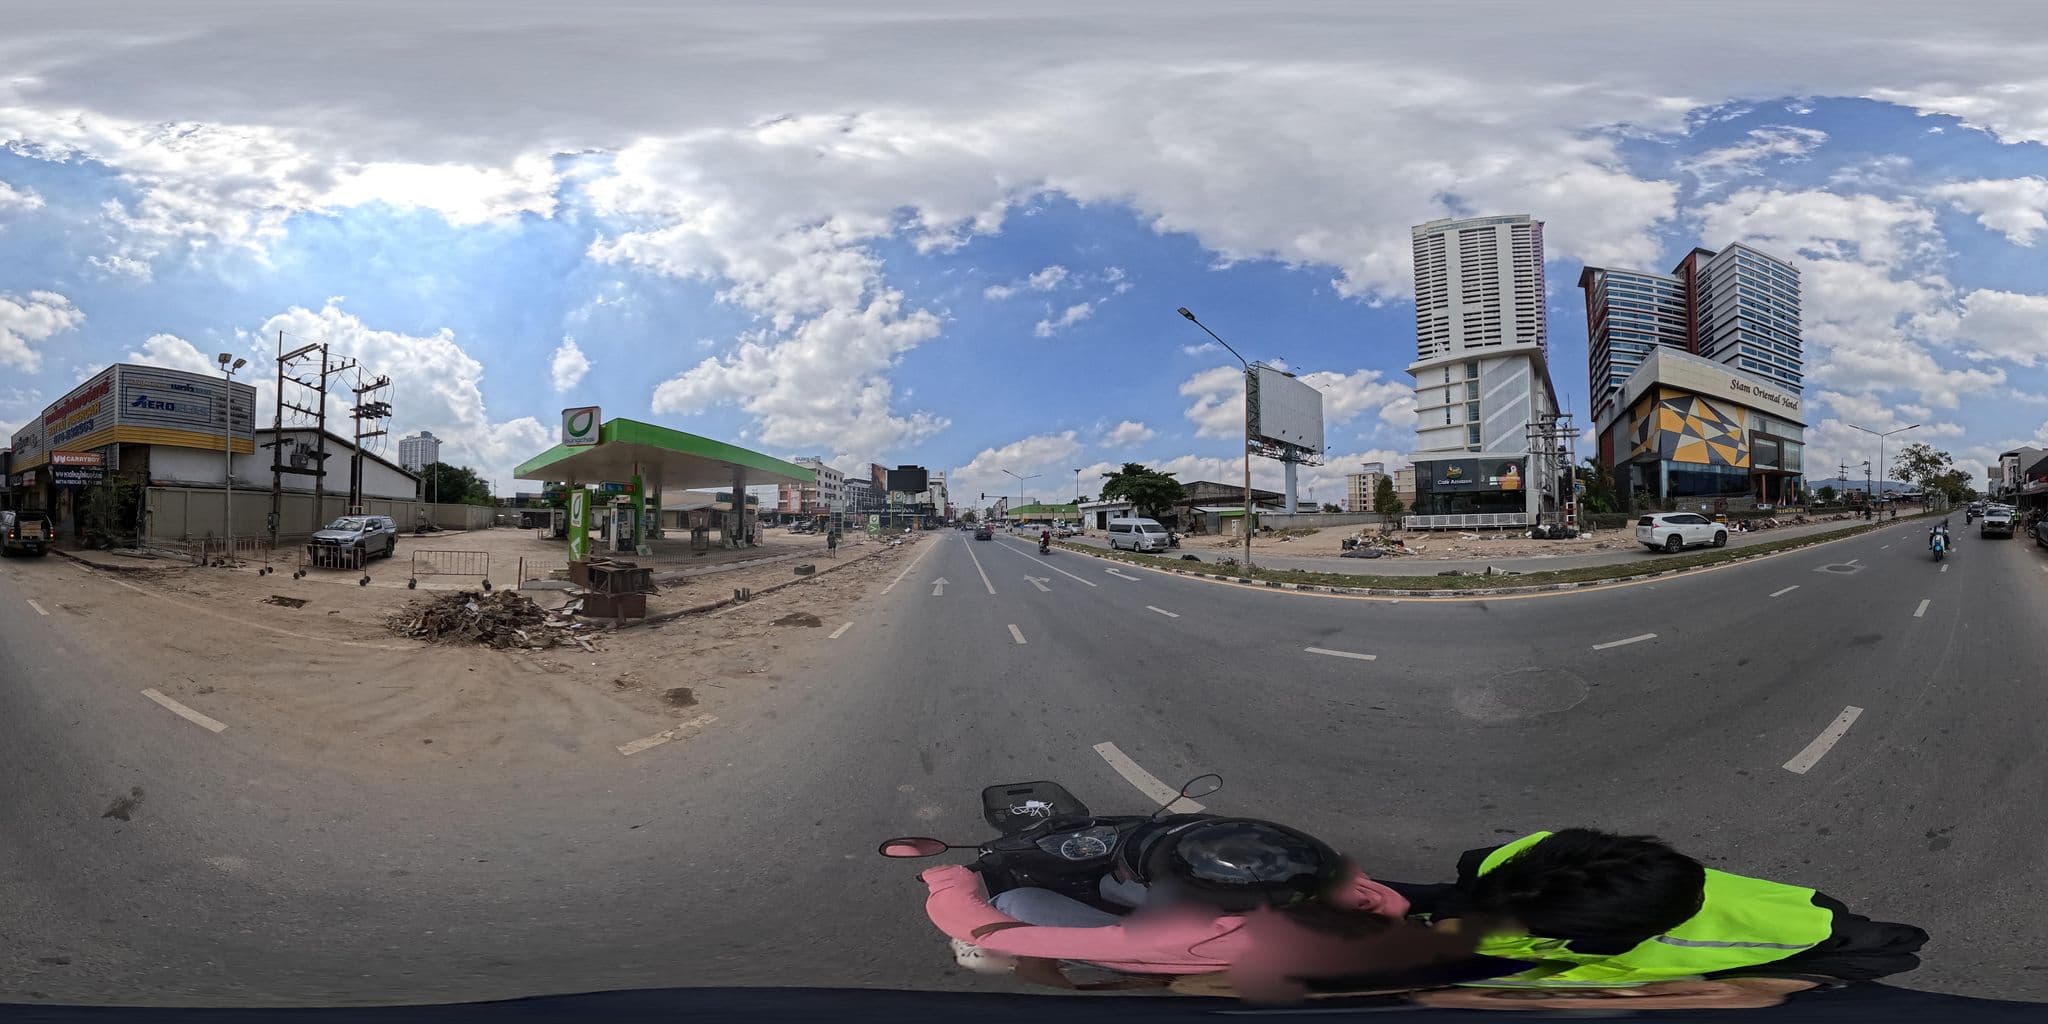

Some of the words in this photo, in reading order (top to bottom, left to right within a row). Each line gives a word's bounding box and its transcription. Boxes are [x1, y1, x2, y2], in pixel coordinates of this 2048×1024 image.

[1730, 379, 1750, 393] Siam
[1753, 386, 1781, 403] Oriental
[1782, 397, 1798, 410] Hotel
